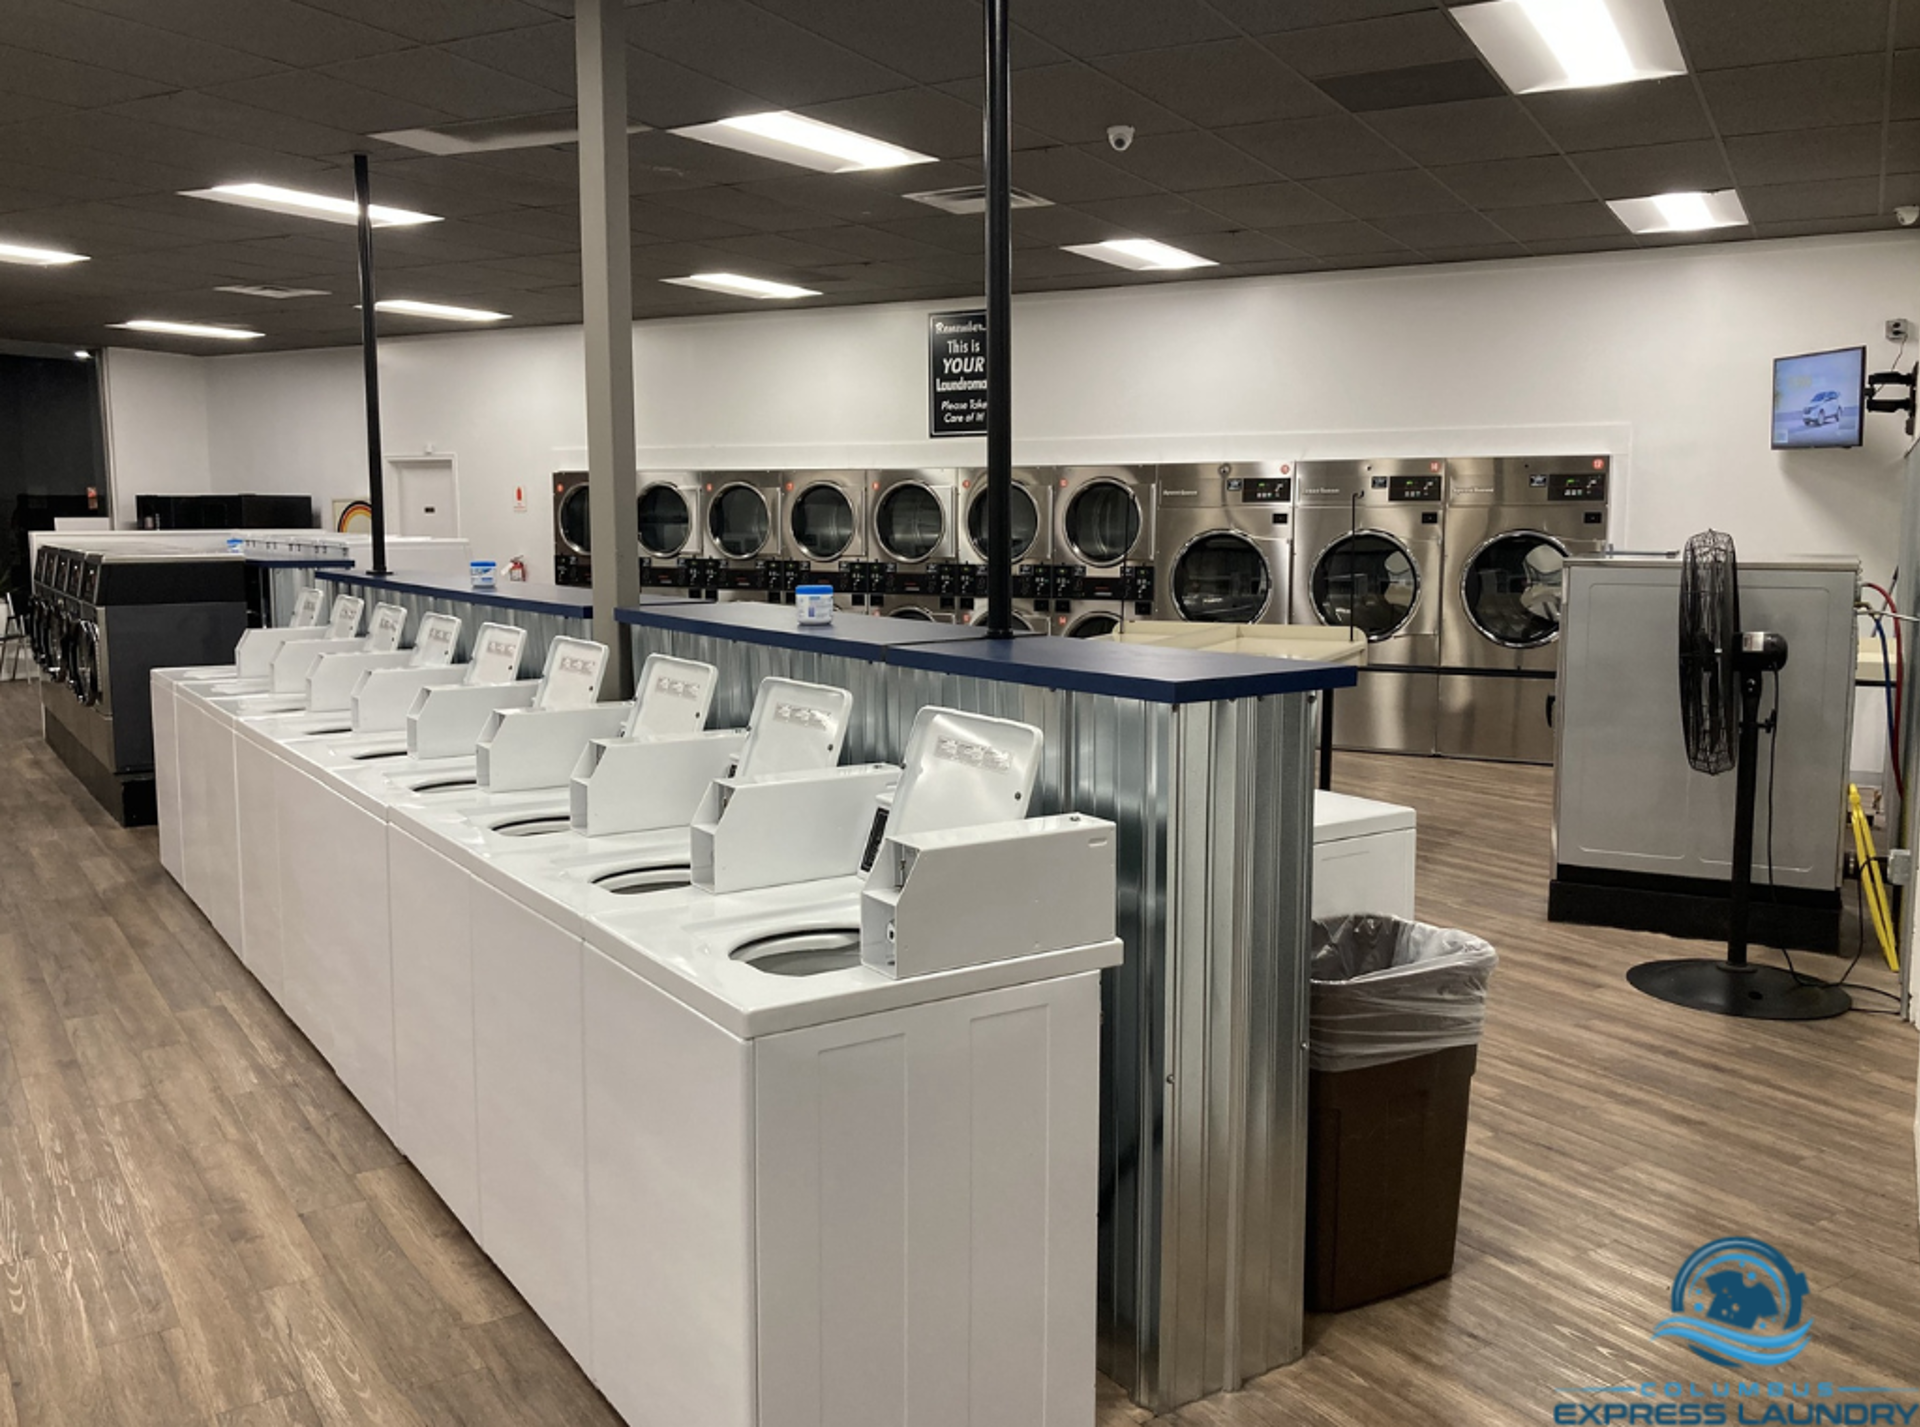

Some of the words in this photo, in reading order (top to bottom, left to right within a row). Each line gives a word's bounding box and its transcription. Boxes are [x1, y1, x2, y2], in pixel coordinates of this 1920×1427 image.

[947, 340, 968, 353] This
[971, 339, 980, 353] is
[942, 356, 985, 374] YOUR
[935, 376, 987, 392] Laundroma
[941, 400, 968, 411] Please
[943, 412, 963, 423] Care
[965, 412, 975, 423] of
